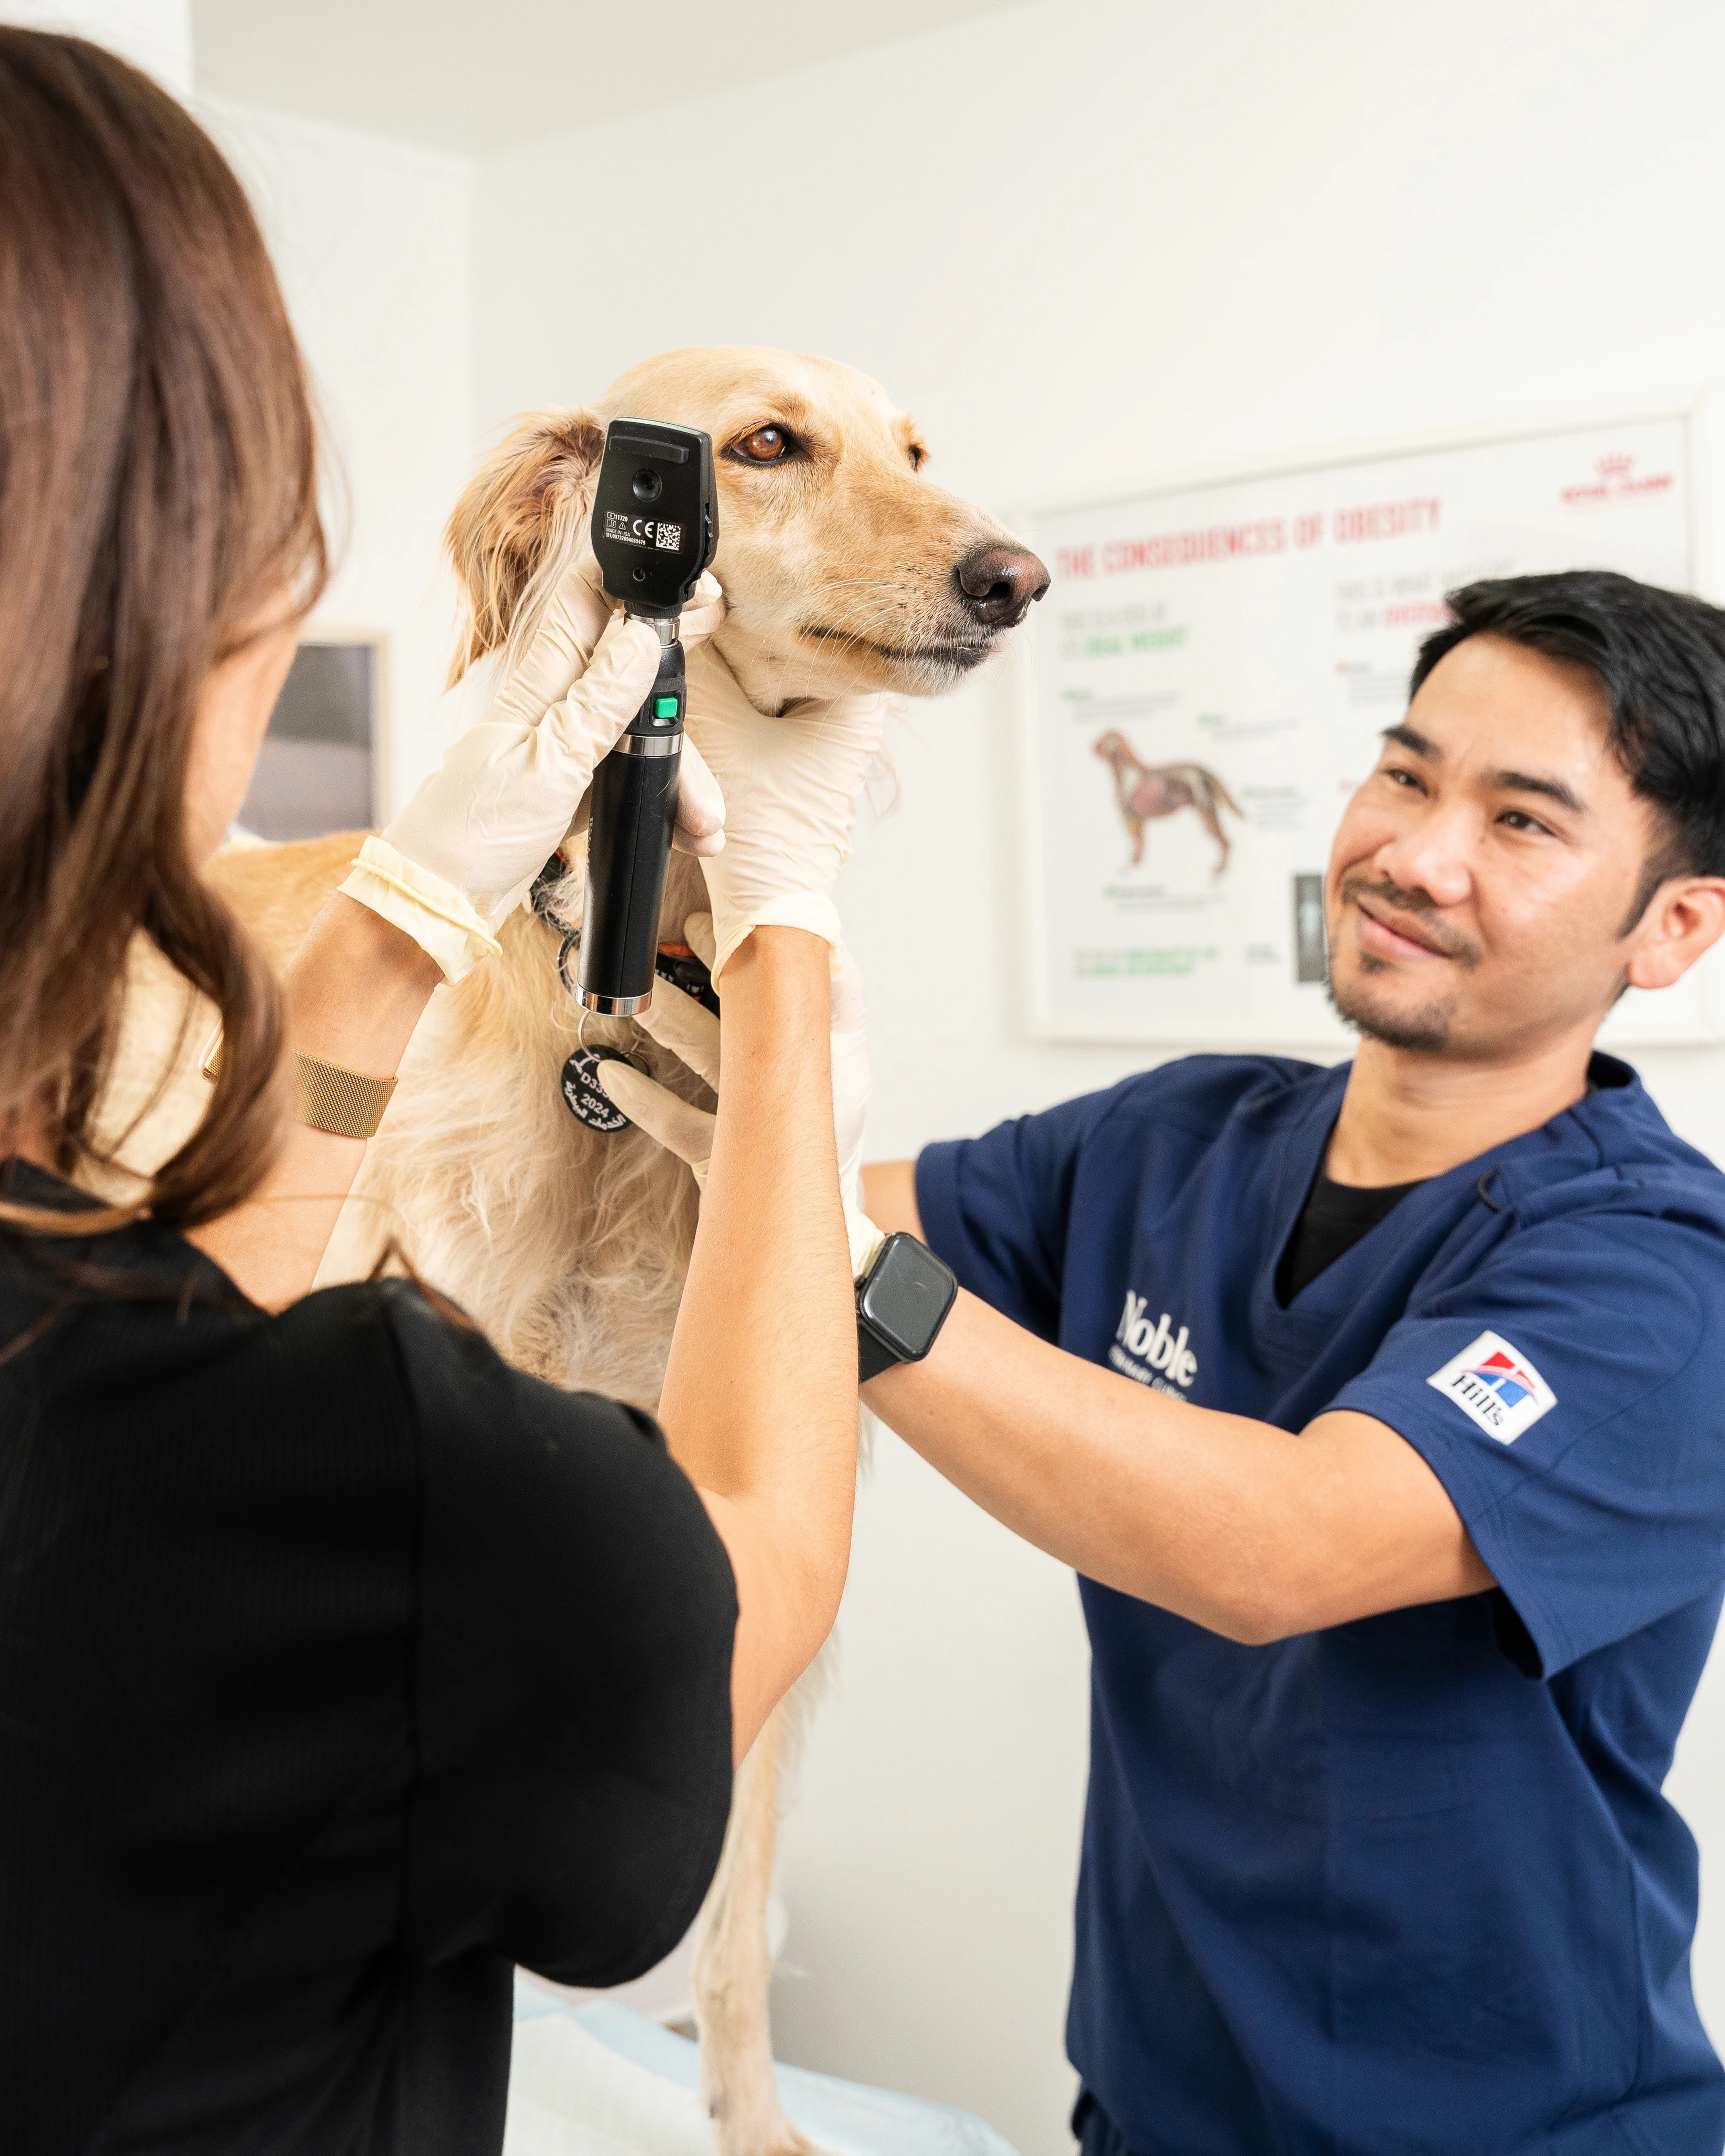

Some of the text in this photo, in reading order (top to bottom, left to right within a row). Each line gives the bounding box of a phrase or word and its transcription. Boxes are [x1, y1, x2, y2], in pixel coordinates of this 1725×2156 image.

[605, 532, 646, 545] (01)00732094089479
[1056, 497, 1441, 578] THE CONSEQUENCES OF OBESITY
[581, 1093, 610, 1118] 2024
[1115, 1289, 1198, 1388] Noble
